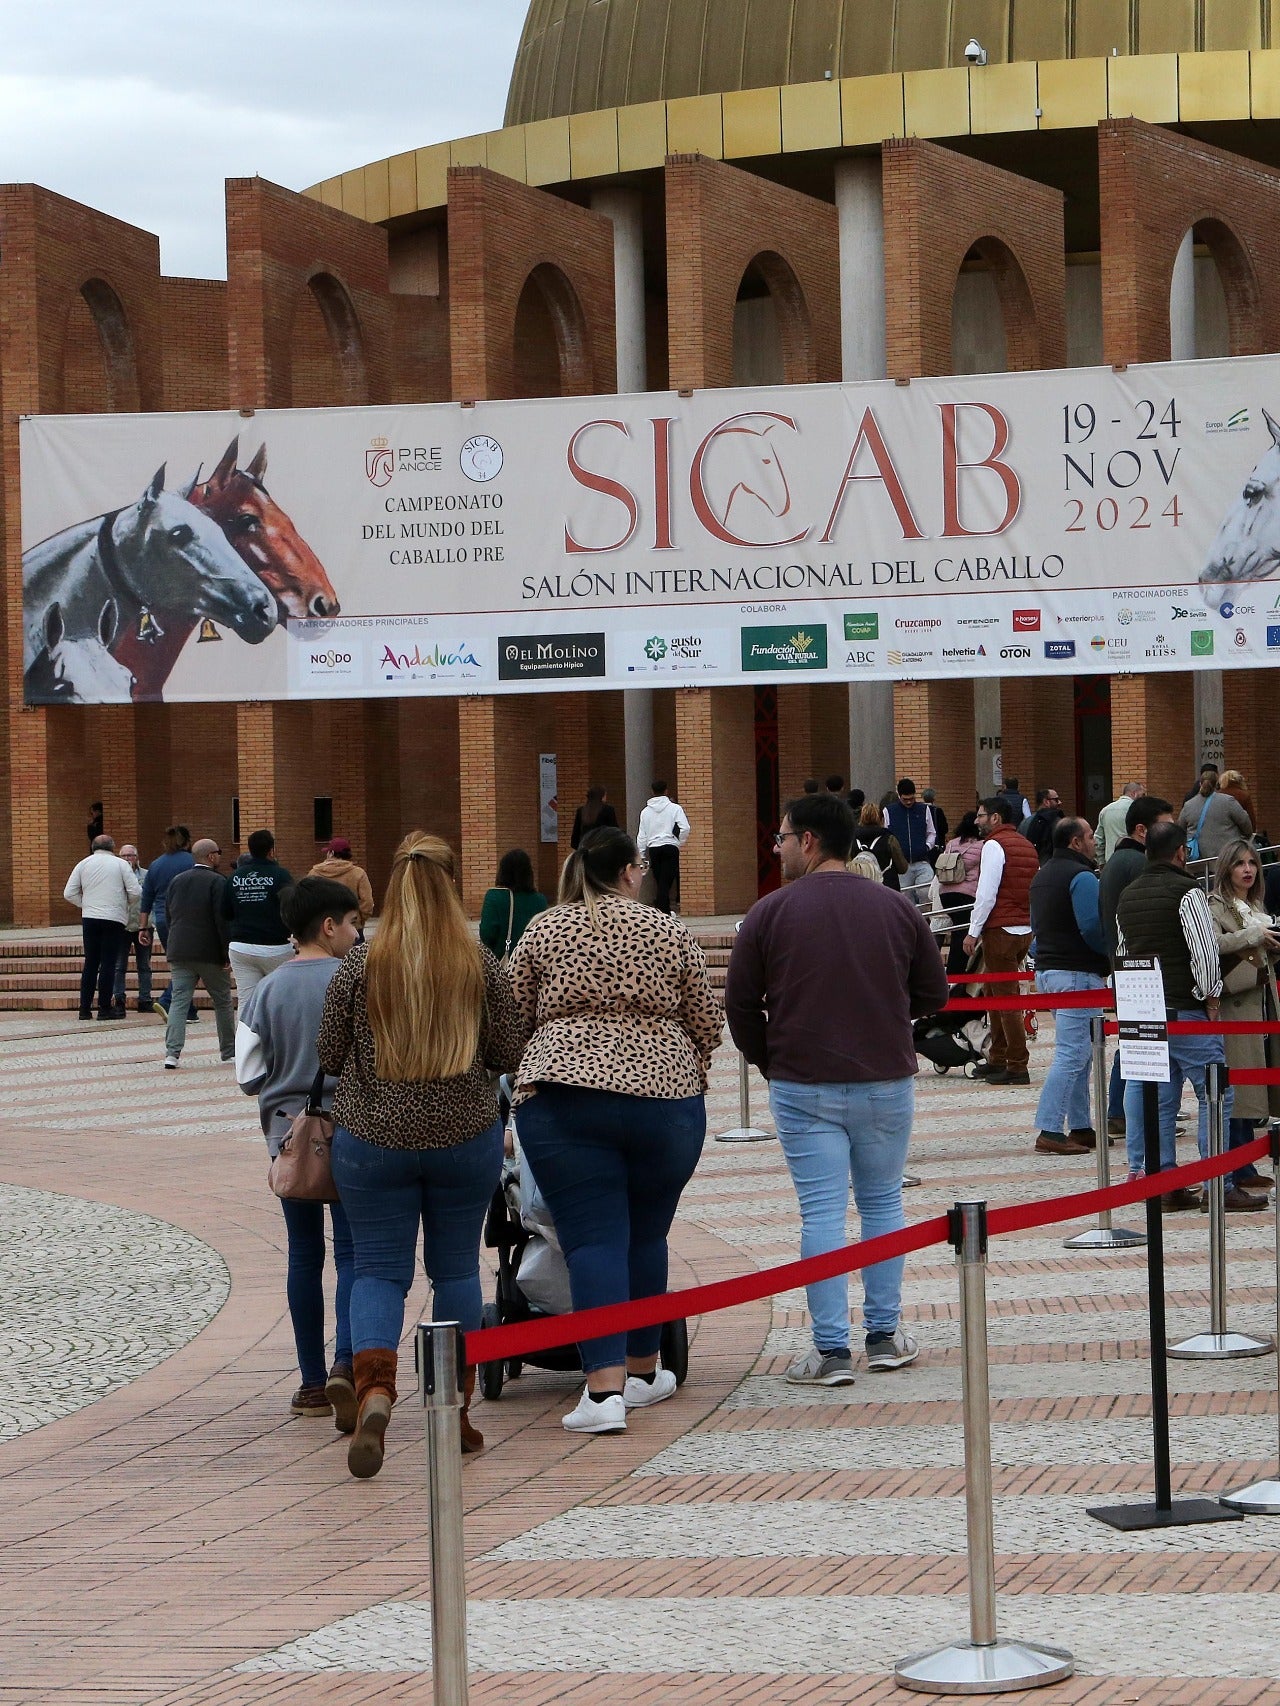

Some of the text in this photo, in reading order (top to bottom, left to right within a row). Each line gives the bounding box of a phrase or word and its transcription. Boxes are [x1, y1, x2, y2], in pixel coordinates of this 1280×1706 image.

[1062, 403, 1096, 443] 19
[1134, 397, 1182, 440] 24
[464, 437, 498, 453] SICAB
[398, 447, 442, 461] PRE
[399, 461, 442, 472] ANCCE
[1062, 447, 1182, 491] NOV
[563, 401, 1021, 554] SICAB
[384, 493, 503, 513] CAMPEONATO
[1063, 494, 1184, 532] 2024
[362, 520, 504, 540] DEL MUNDO DEL
[389, 546, 505, 566] CABALLO PRE
[521, 554, 1064, 600] SALÓN INTERNACIONAL DEL CABALLO
[1112, 588, 1189, 600] PATROCINADORES
[740, 604, 787, 613] COLABORA
[1234, 605, 1256, 615] COPE
[298, 617, 429, 629] PATROCINADORES PRINCIPALES
[894, 618, 942, 629] Cruzcampo
[1064, 614, 1105, 623] exteriorplus
[671, 635, 702, 651] gusto
[1107, 638, 1128, 648] CEU
[520, 650, 533, 661] EL
[680, 646, 702, 659] Sur
[750, 643, 796, 656] Fundación
[942, 648, 976, 657] helvetia
[999, 648, 1031, 659] OTON
[1145, 648, 1177, 657] BLISS
[379, 642, 482, 670] Andalucía
[845, 651, 876, 663] ABC
[519, 662, 563, 671] Equipamiento
